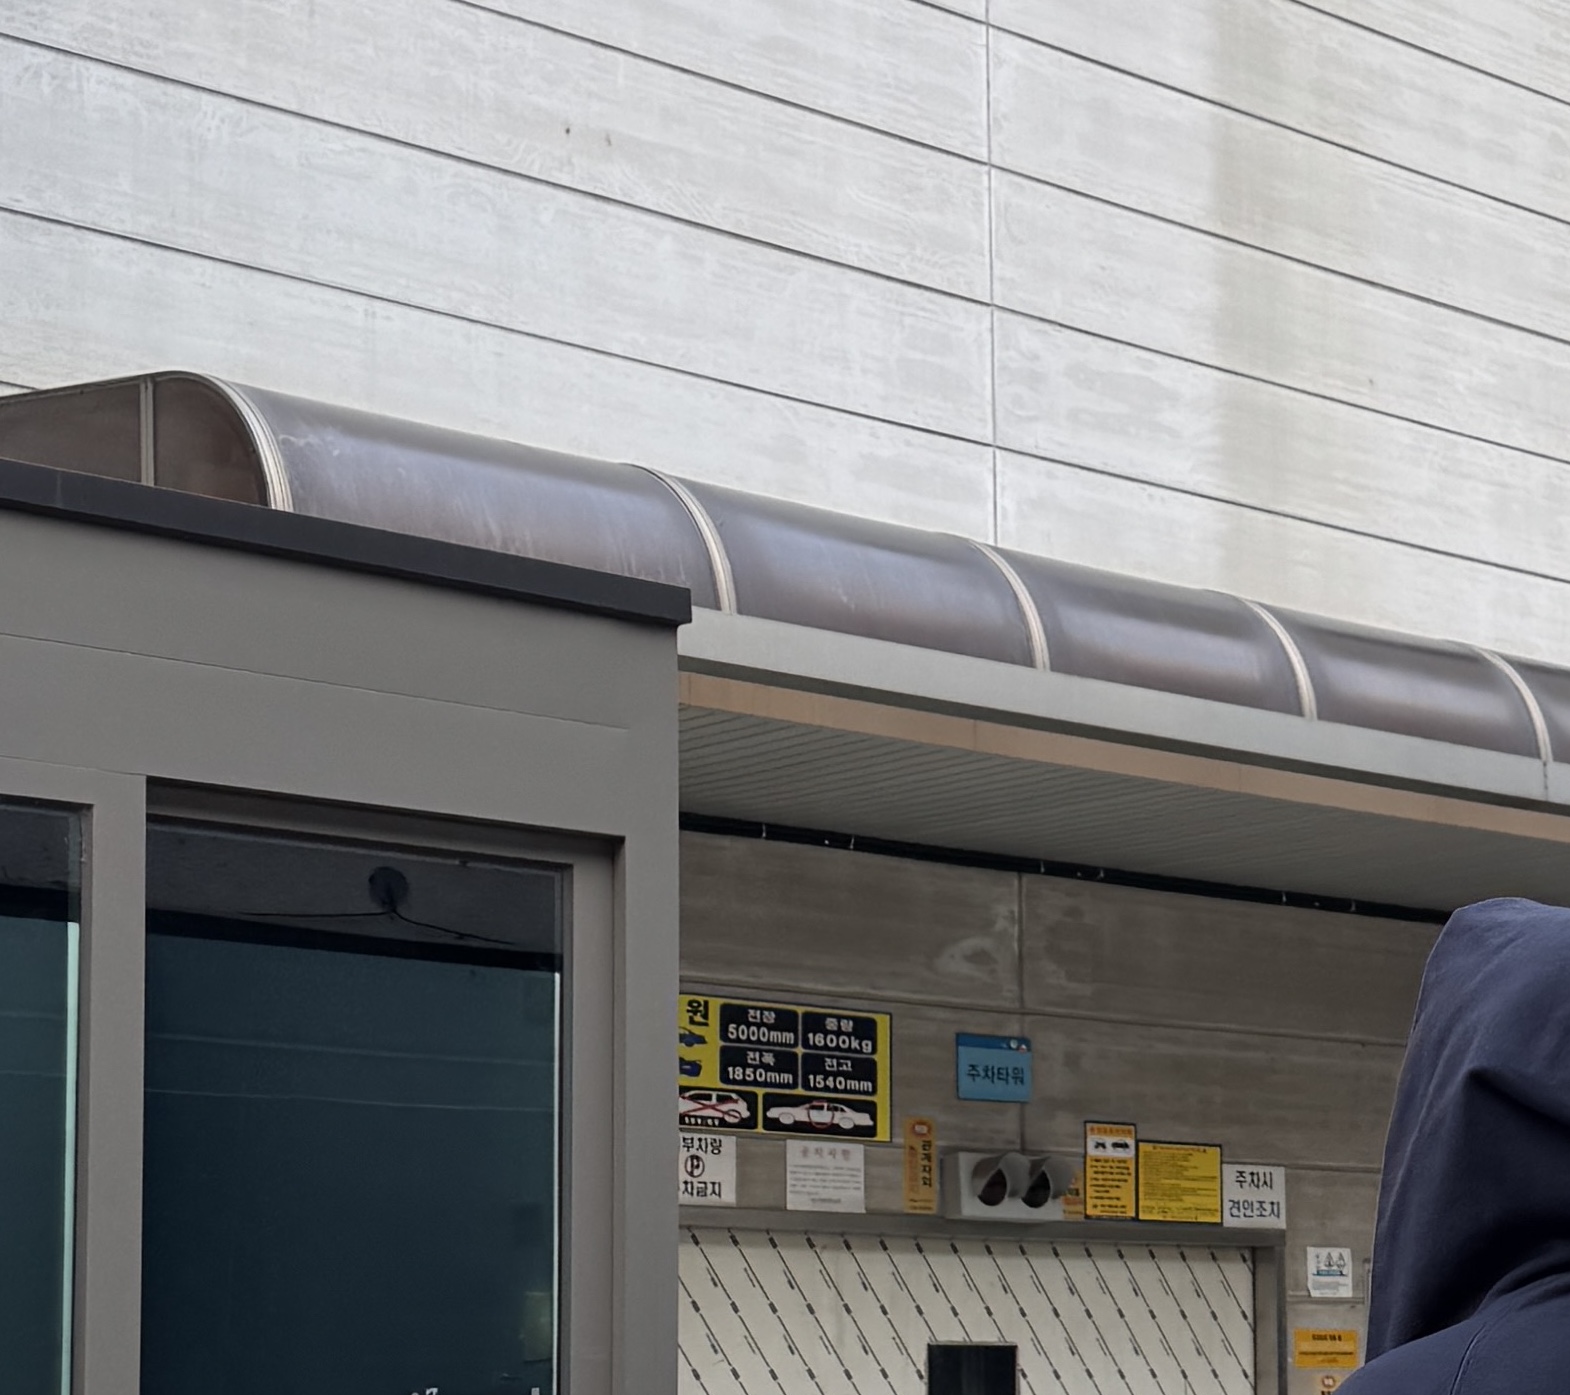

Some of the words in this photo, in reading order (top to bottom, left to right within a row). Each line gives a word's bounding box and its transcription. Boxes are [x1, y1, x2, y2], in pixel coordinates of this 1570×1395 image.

[686, 999, 709, 1026] 원
[747, 1009, 776, 1024] 전장
[727, 1023, 795, 1044] 5000mm
[825, 1017, 853, 1033] 중량
[807, 1032, 872, 1054] 1600kg
[746, 1050, 776, 1067] 전폭
[824, 1057, 852, 1072] 전고
[727, 1066, 793, 1085] 1850mm
[808, 1074, 873, 1092] 1540mm
[966, 1063, 1025, 1086] 주차타워
[679, 1180, 722, 1199] 차금지
[1235, 1170, 1273, 1190] 주차시
[1228, 1199, 1281, 1219] 견인조치
